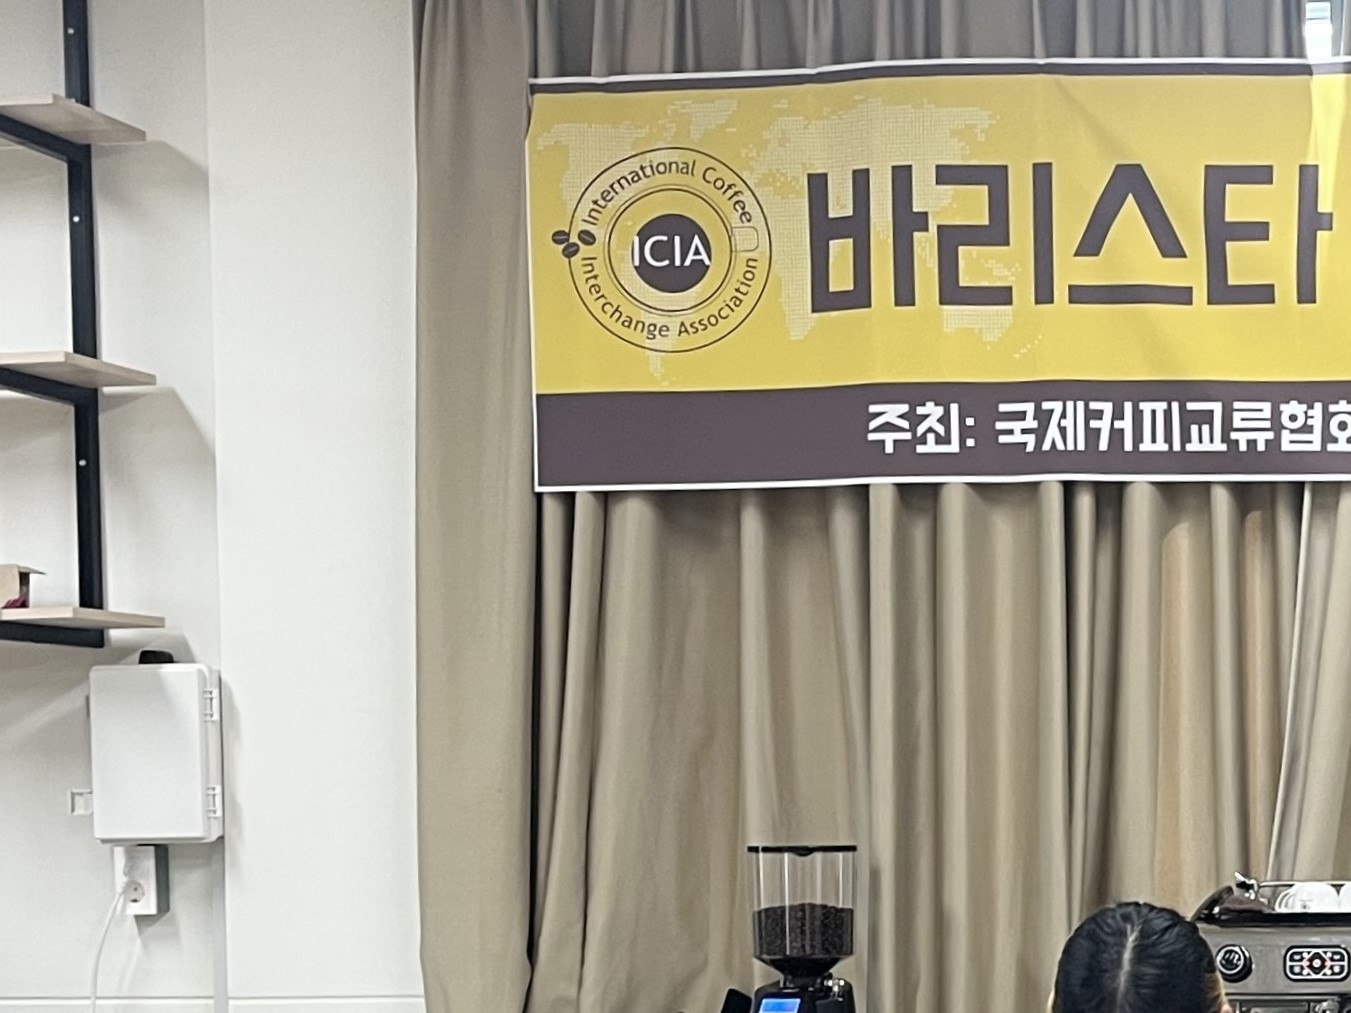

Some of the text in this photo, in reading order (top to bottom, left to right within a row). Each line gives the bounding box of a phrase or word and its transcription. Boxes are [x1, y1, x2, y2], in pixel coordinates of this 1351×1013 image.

[581, 159, 753, 226] International Coffee
[632, 233, 711, 268] ICIA
[807, 161, 1334, 314] 바리스타
[580, 256, 759, 341] Interchange Association
[866, 401, 976, 455] 주최:
